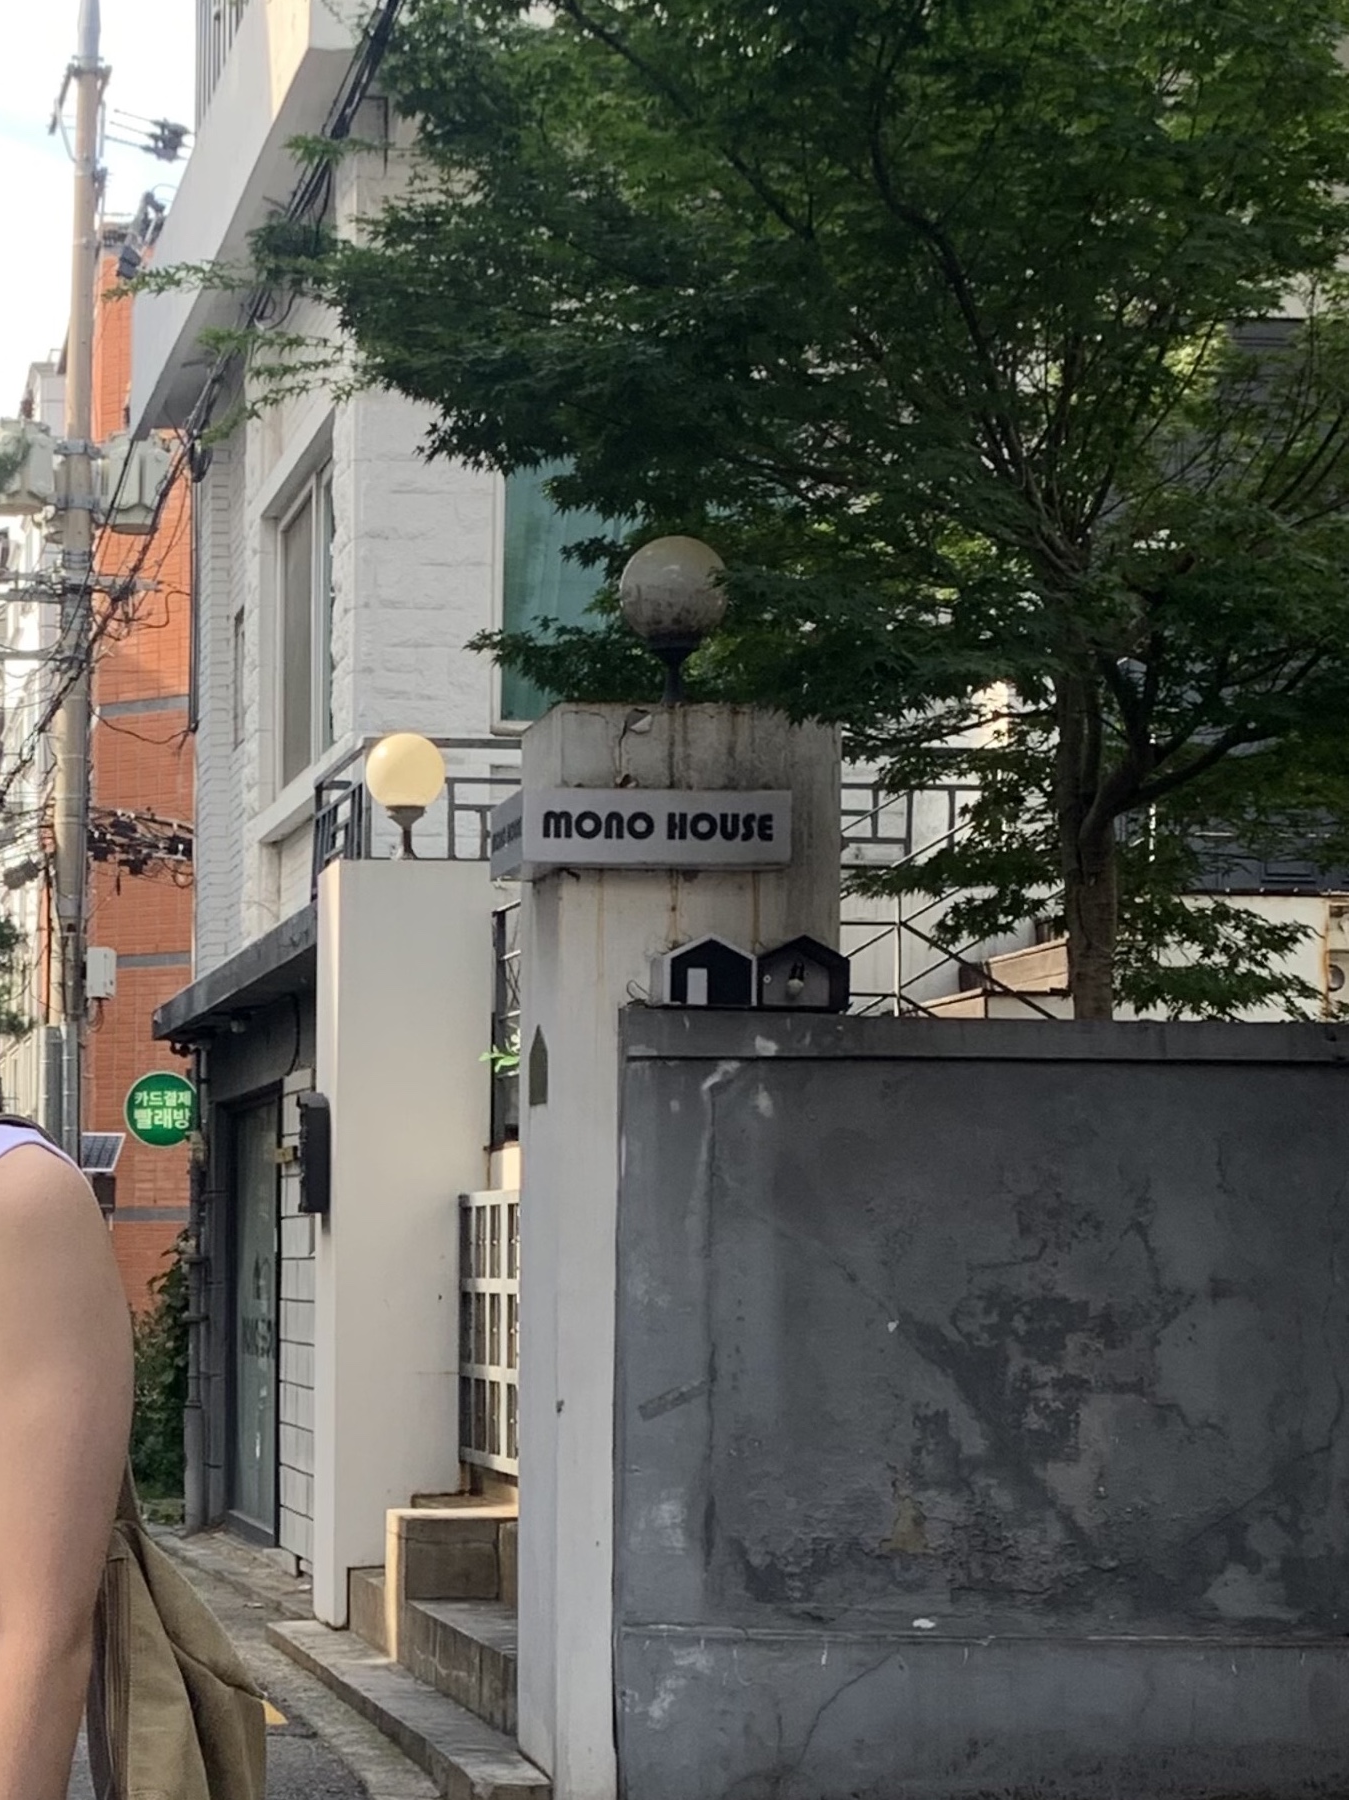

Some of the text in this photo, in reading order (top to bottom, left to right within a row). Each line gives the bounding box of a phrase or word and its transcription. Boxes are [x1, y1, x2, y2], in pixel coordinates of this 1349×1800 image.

[666, 812, 773, 841] HOUSE
[134, 1091, 191, 1107] 카드결제
[134, 1108, 191, 1129] 빨래방
